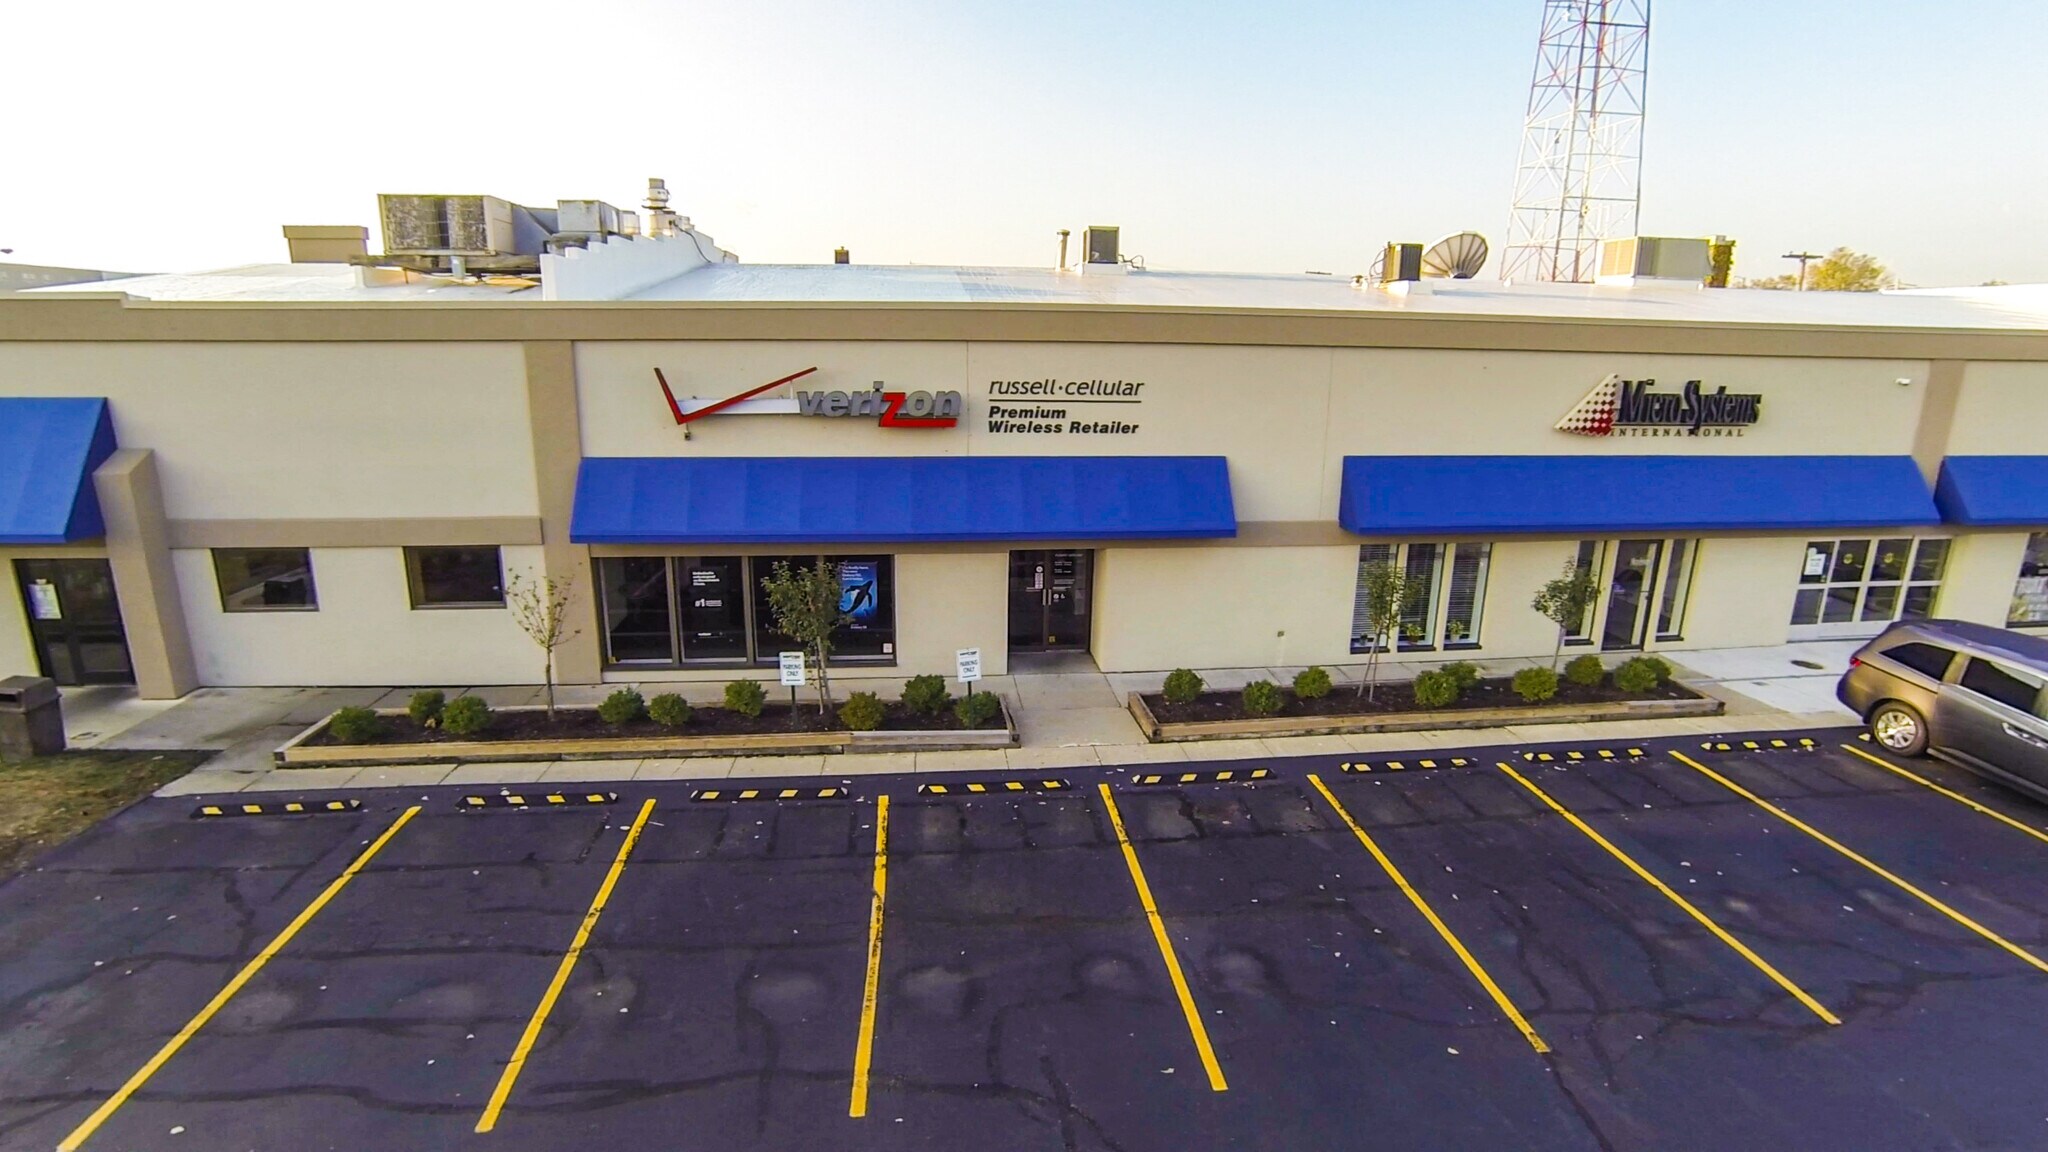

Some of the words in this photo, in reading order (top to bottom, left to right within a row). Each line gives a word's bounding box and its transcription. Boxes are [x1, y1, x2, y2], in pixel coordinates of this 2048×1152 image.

[797, 381, 962, 428] verizon
[988, 405, 1067, 419] Premium
[988, 420, 1063, 434] Wireless
[1069, 421, 1139, 434] Retailer
